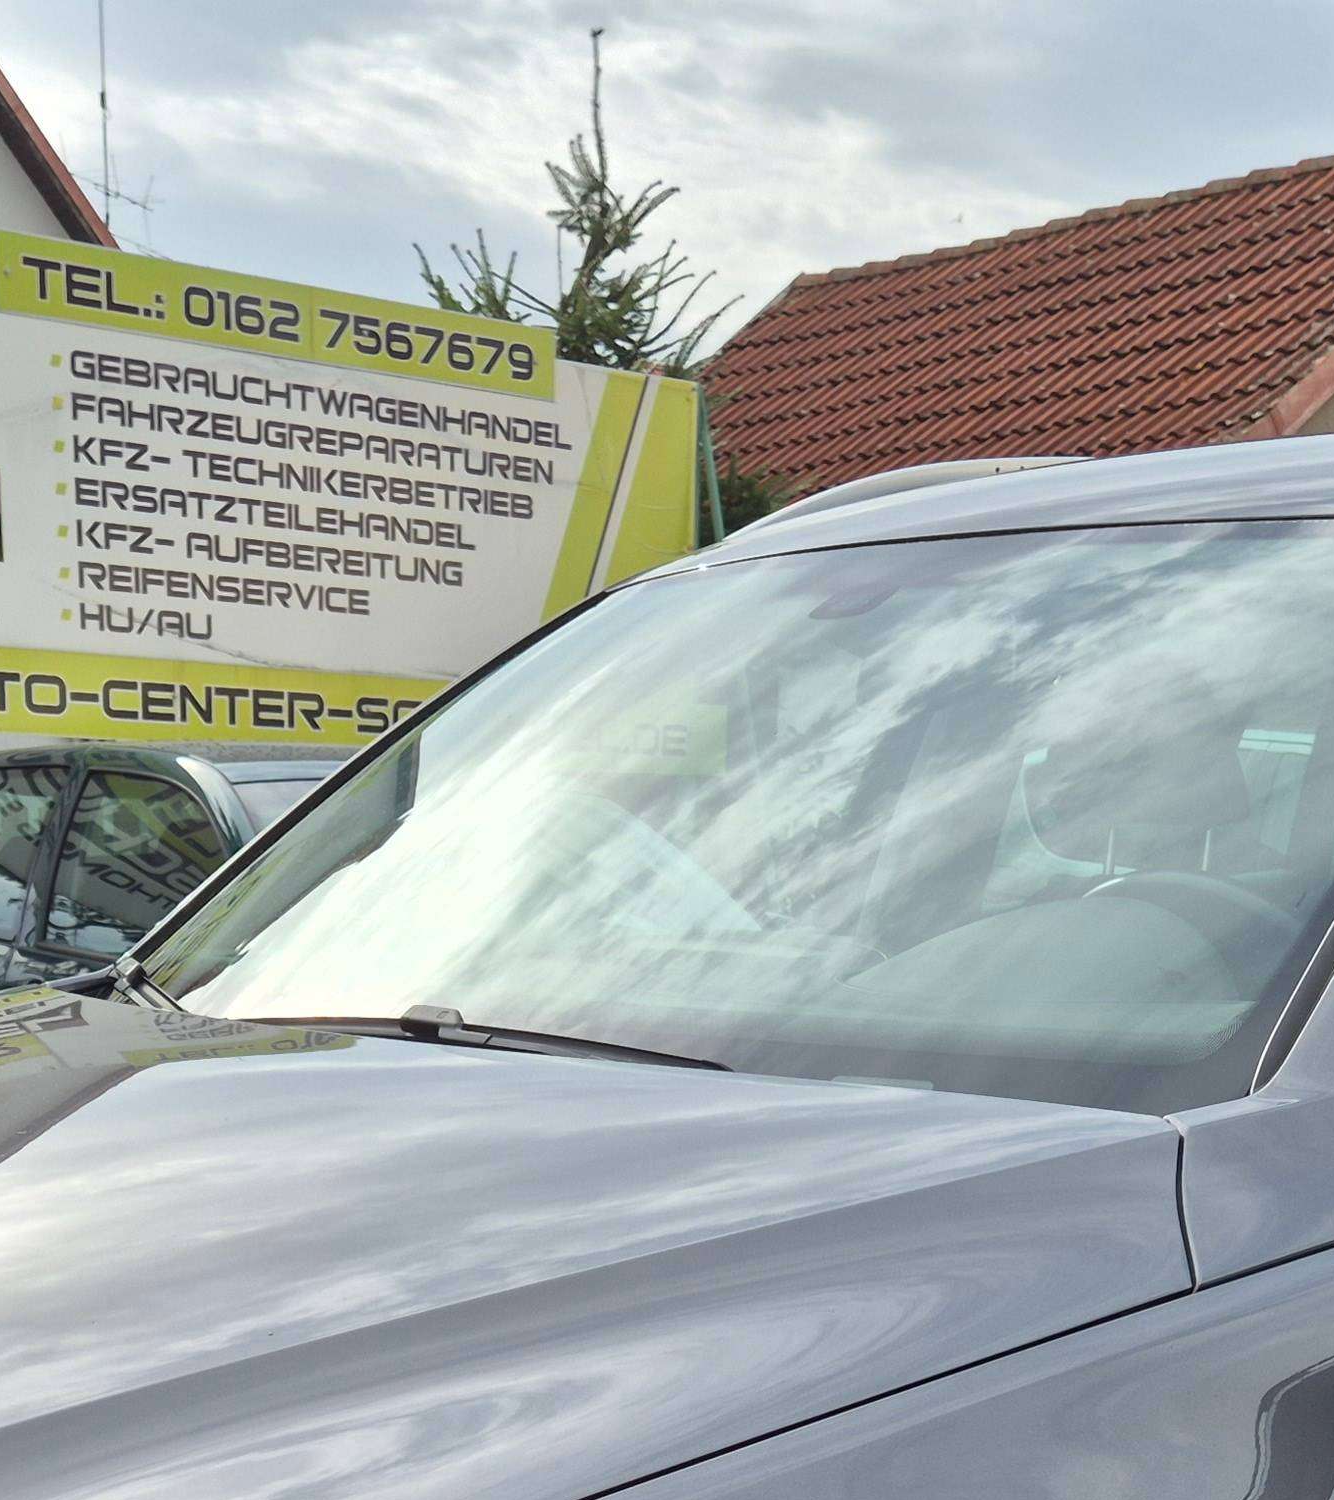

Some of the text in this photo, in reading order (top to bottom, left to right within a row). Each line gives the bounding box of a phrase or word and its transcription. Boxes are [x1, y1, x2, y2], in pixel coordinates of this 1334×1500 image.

[22, 256, 535, 380] TEL.: 0162 7567679
[69, 350, 572, 451] GEBRAUCHTWAGENHANDEL
[71, 394, 553, 485] FAHRZEUGREPARATUREN
[73, 436, 533, 519] KFZ- TECHNIKERBETRIEB
[75, 479, 476, 550] ERSATZTEILEHANDEL
[76, 520, 463, 586] KFZ- AUFBEREITUNG
[78, 562, 370, 616] REIFENSERVICE
[79, 603, 213, 640] HU/AU
